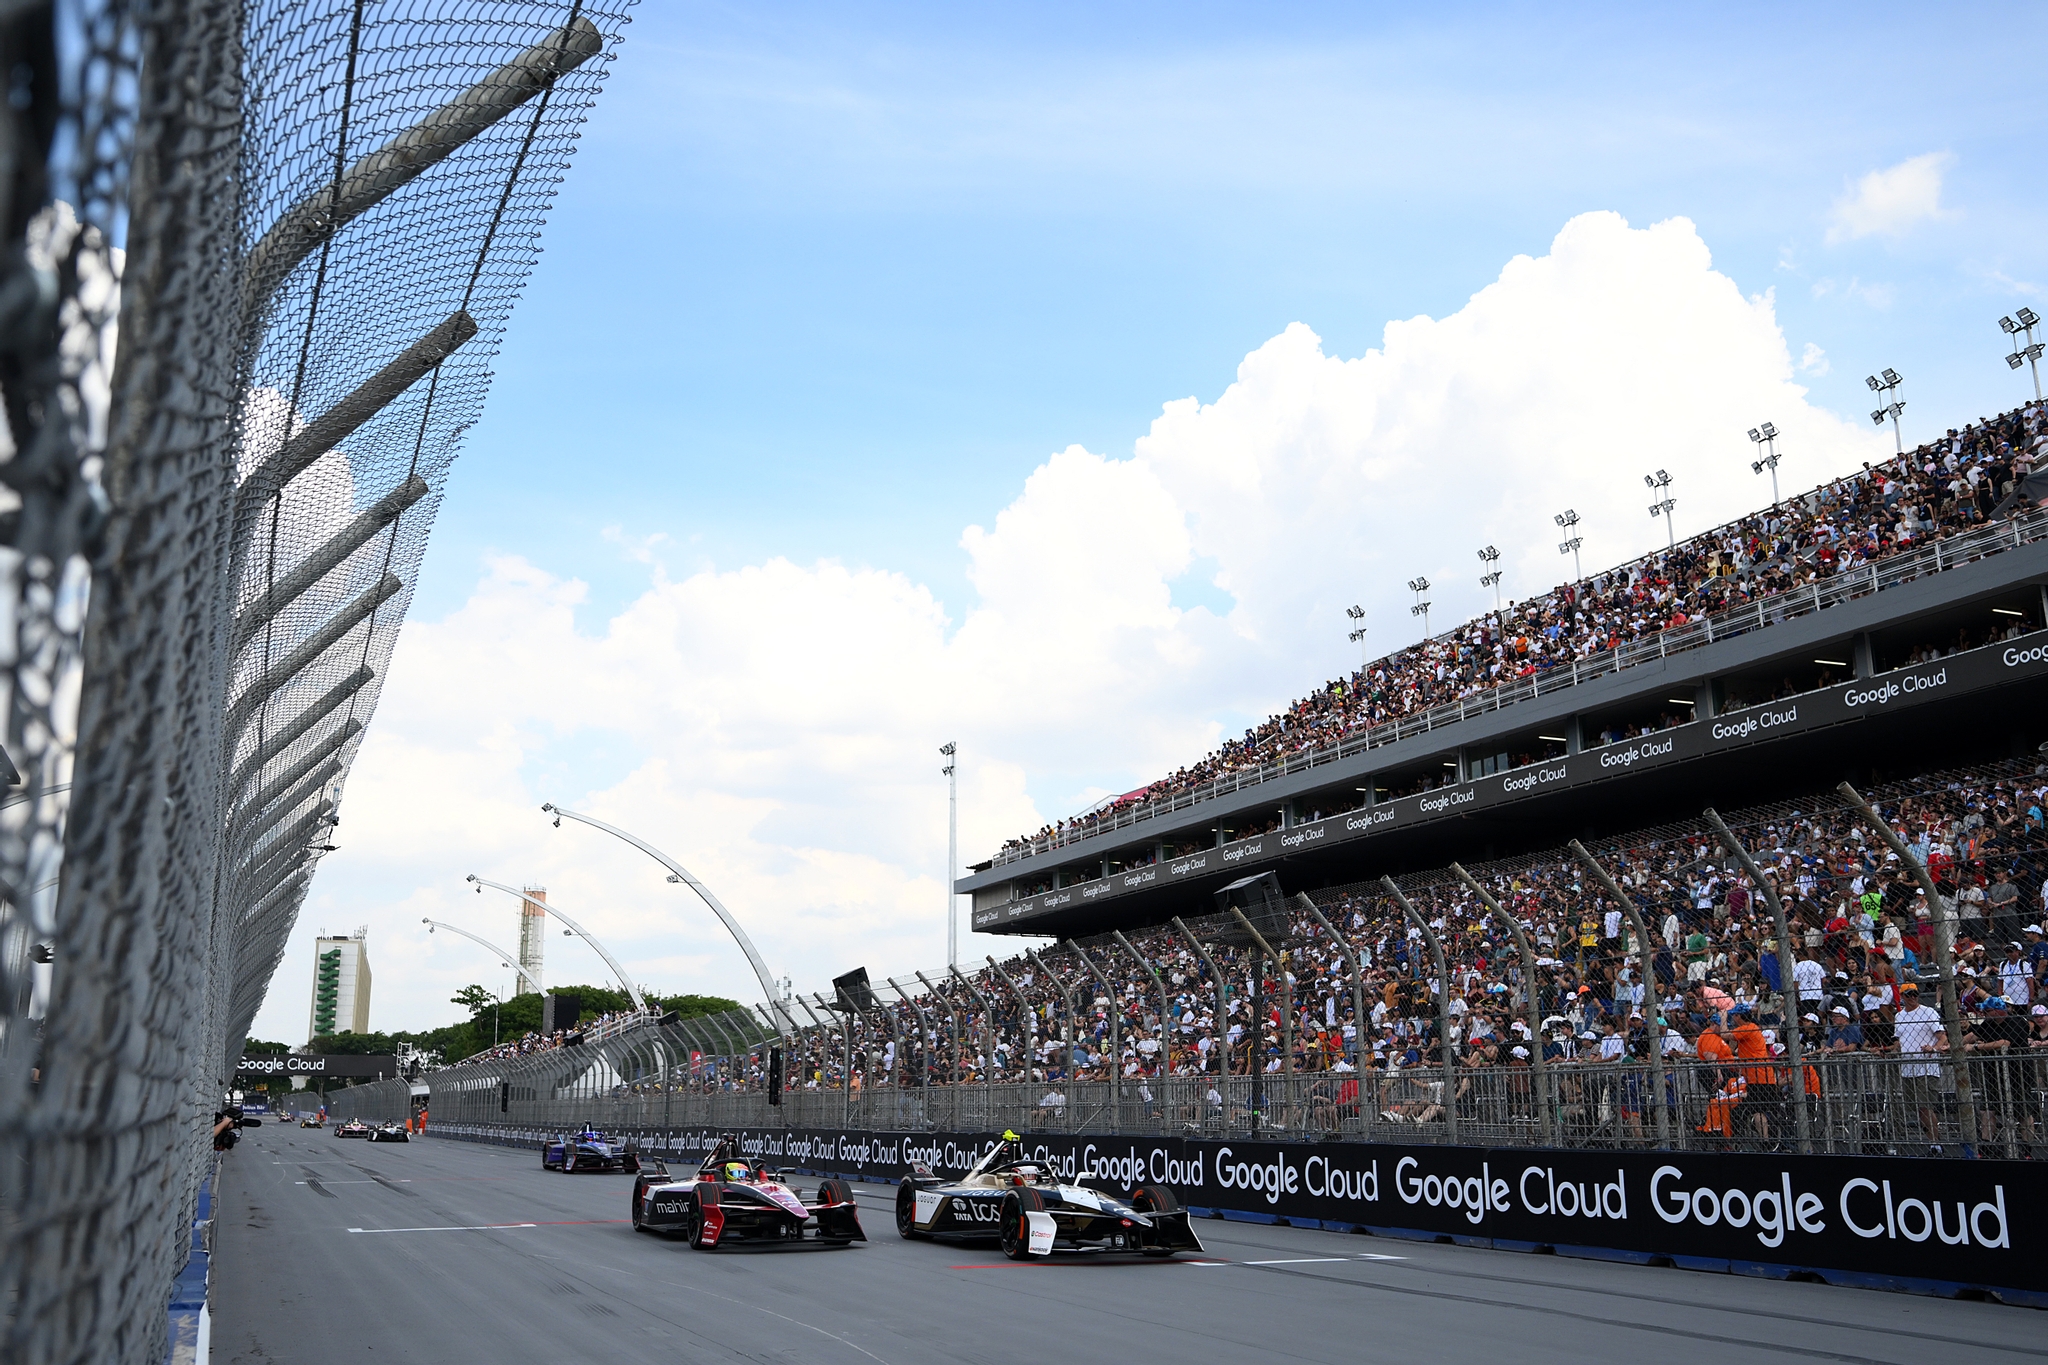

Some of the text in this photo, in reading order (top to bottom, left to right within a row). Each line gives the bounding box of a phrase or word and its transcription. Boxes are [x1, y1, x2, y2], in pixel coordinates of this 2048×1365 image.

[1845, 668, 1947, 707] Google Cloud
[1712, 706, 1797, 740] Google Cloud
[1600, 738, 1672, 768] Google Cloud
[1503, 765, 1566, 792] Google Cloud
[1420, 788, 1474, 812] Google Cloud
[1346, 808, 1395, 830] Google Cloud
[1281, 826, 1324, 846] Google Cloud
[1223, 842, 1261, 862] Google Cloud
[1171, 857, 1206, 875] Google Cloud
[1083, 882, 1110, 898] Google Cloud
[1124, 870, 1155, 887] Google Cloud
[1009, 902, 1033, 916] Google Cloud
[1044, 893, 1070, 907] Google Cloud
[1865, 901, 1876, 910] 65
[237, 1056, 325, 1073] Google Cloud
[640, 1131, 667, 1153] Google Cloud
[669, 1131, 700, 1155] Google Cloud
[741, 1132, 763, 1158] Google
[764, 1134, 783, 1155] Cloud
[786, 1133, 835, 1163] Google Cloud
[839, 1135, 897, 1169] Google Cloud
[903, 1137, 942, 1171] Google
[945, 1141, 977, 1170] Cloud
[1084, 1144, 1203, 1191] Google Cloud
[1215, 1147, 1379, 1204] Google Cloud
[1396, 1156, 1627, 1224] Google Cloud
[954, 1213, 973, 1221] TATA
[1650, 1165, 2010, 1249] Google Cloud
